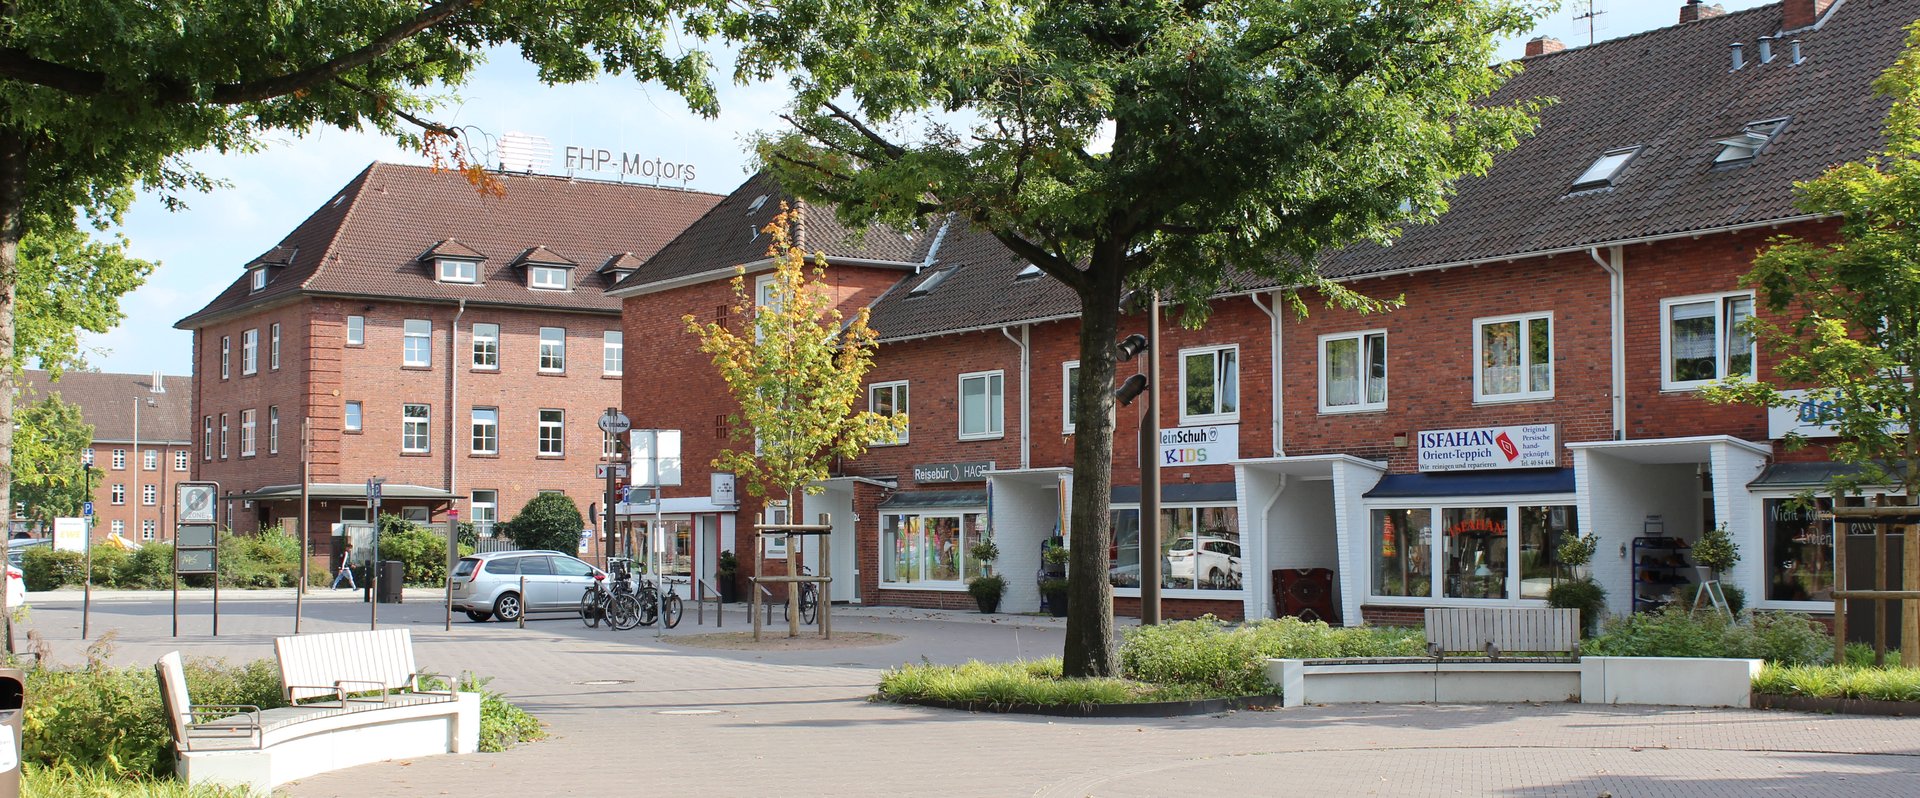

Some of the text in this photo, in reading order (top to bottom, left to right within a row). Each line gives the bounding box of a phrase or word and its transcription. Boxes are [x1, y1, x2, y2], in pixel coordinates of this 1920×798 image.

[566, 146, 695, 181] FHP-Motors
[1522, 426, 1548, 434] Original
[1420, 430, 1494, 449] ISFAHAN
[1165, 448, 1207, 464] KIDS
[1422, 448, 1492, 461] Orient-Teppich
[1522, 450, 1550, 459] geknüpft
